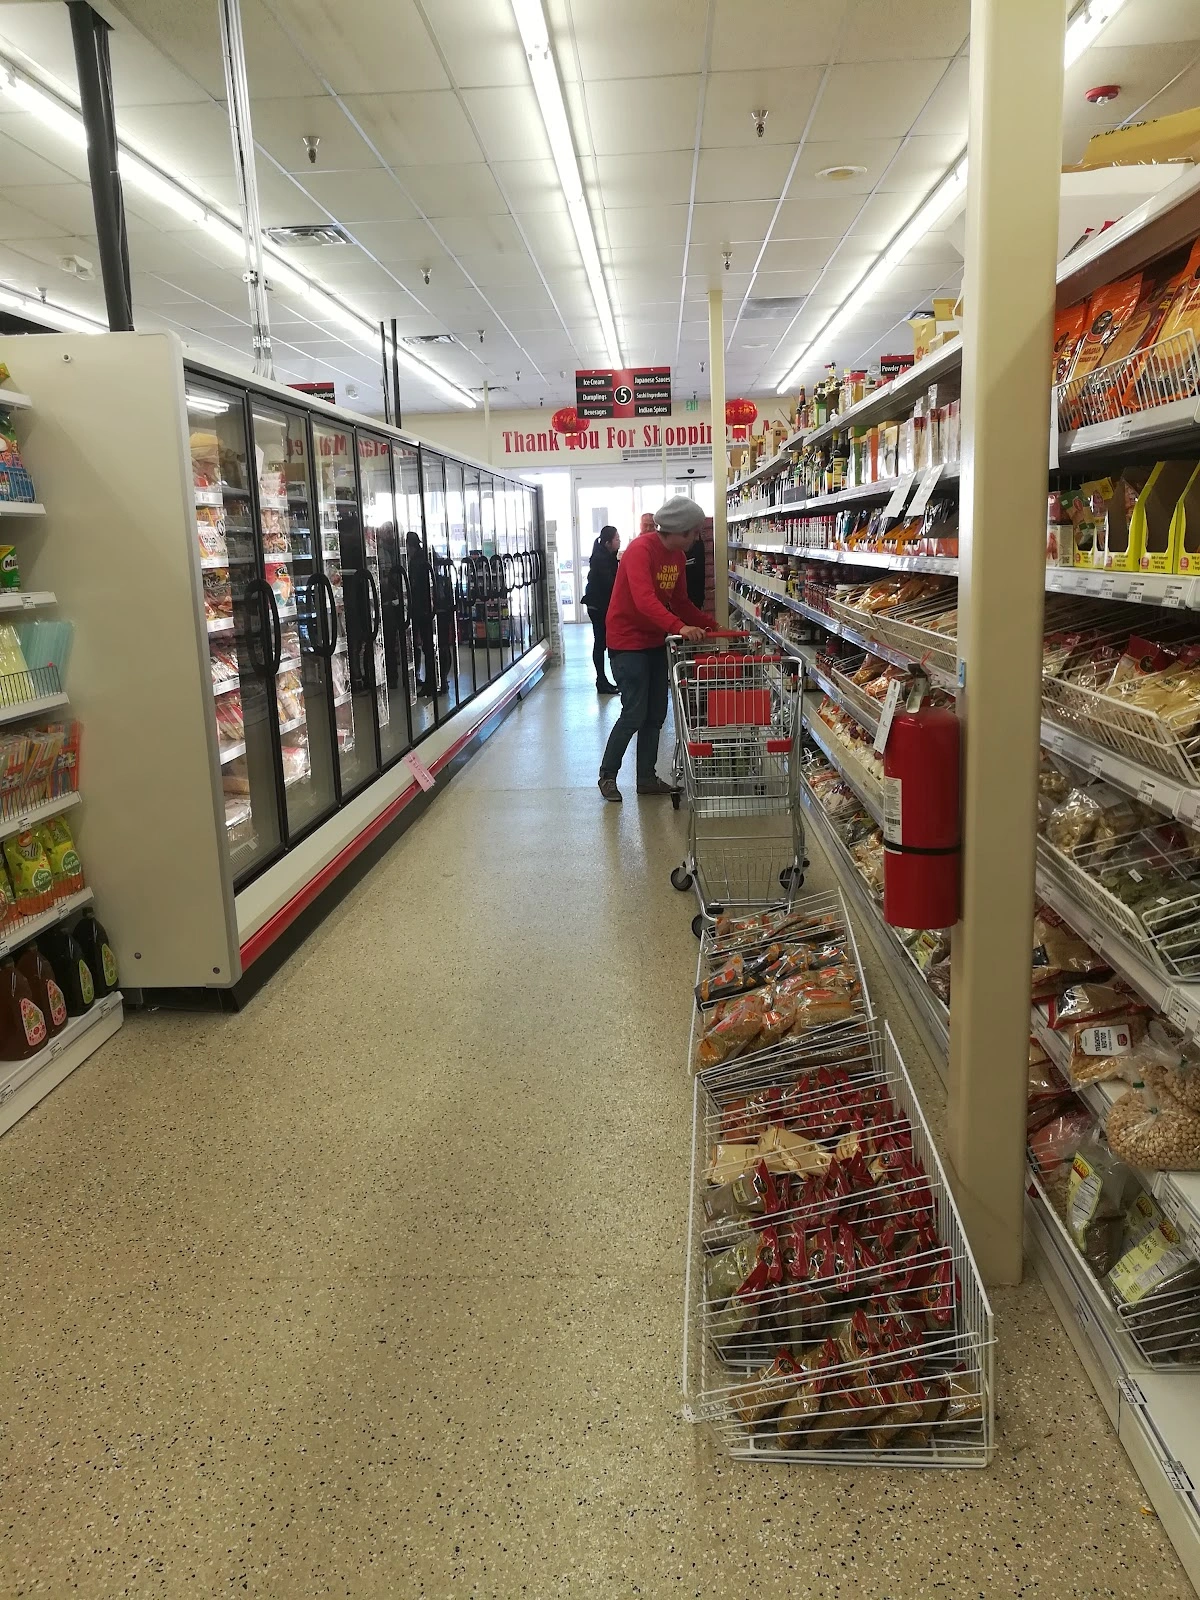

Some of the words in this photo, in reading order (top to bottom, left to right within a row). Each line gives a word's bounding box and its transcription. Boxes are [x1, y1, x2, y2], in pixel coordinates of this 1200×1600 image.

[881, 364, 899, 372] Powder
[590, 378, 605, 386] Cream
[634, 377, 655, 385] Japanese
[582, 393, 607, 402] Dumplings
[620, 388, 627, 403] 5
[638, 406, 653, 414] Indian
[653, 405, 668, 414] Spices
[686, 400, 699, 411] EXIT
[583, 408, 607, 417] Beverages
[502, 429, 560, 453] Thank
[568, 430, 600, 450] ou
[606, 426, 636, 449] For
[643, 422, 722, 447] Shoppin
